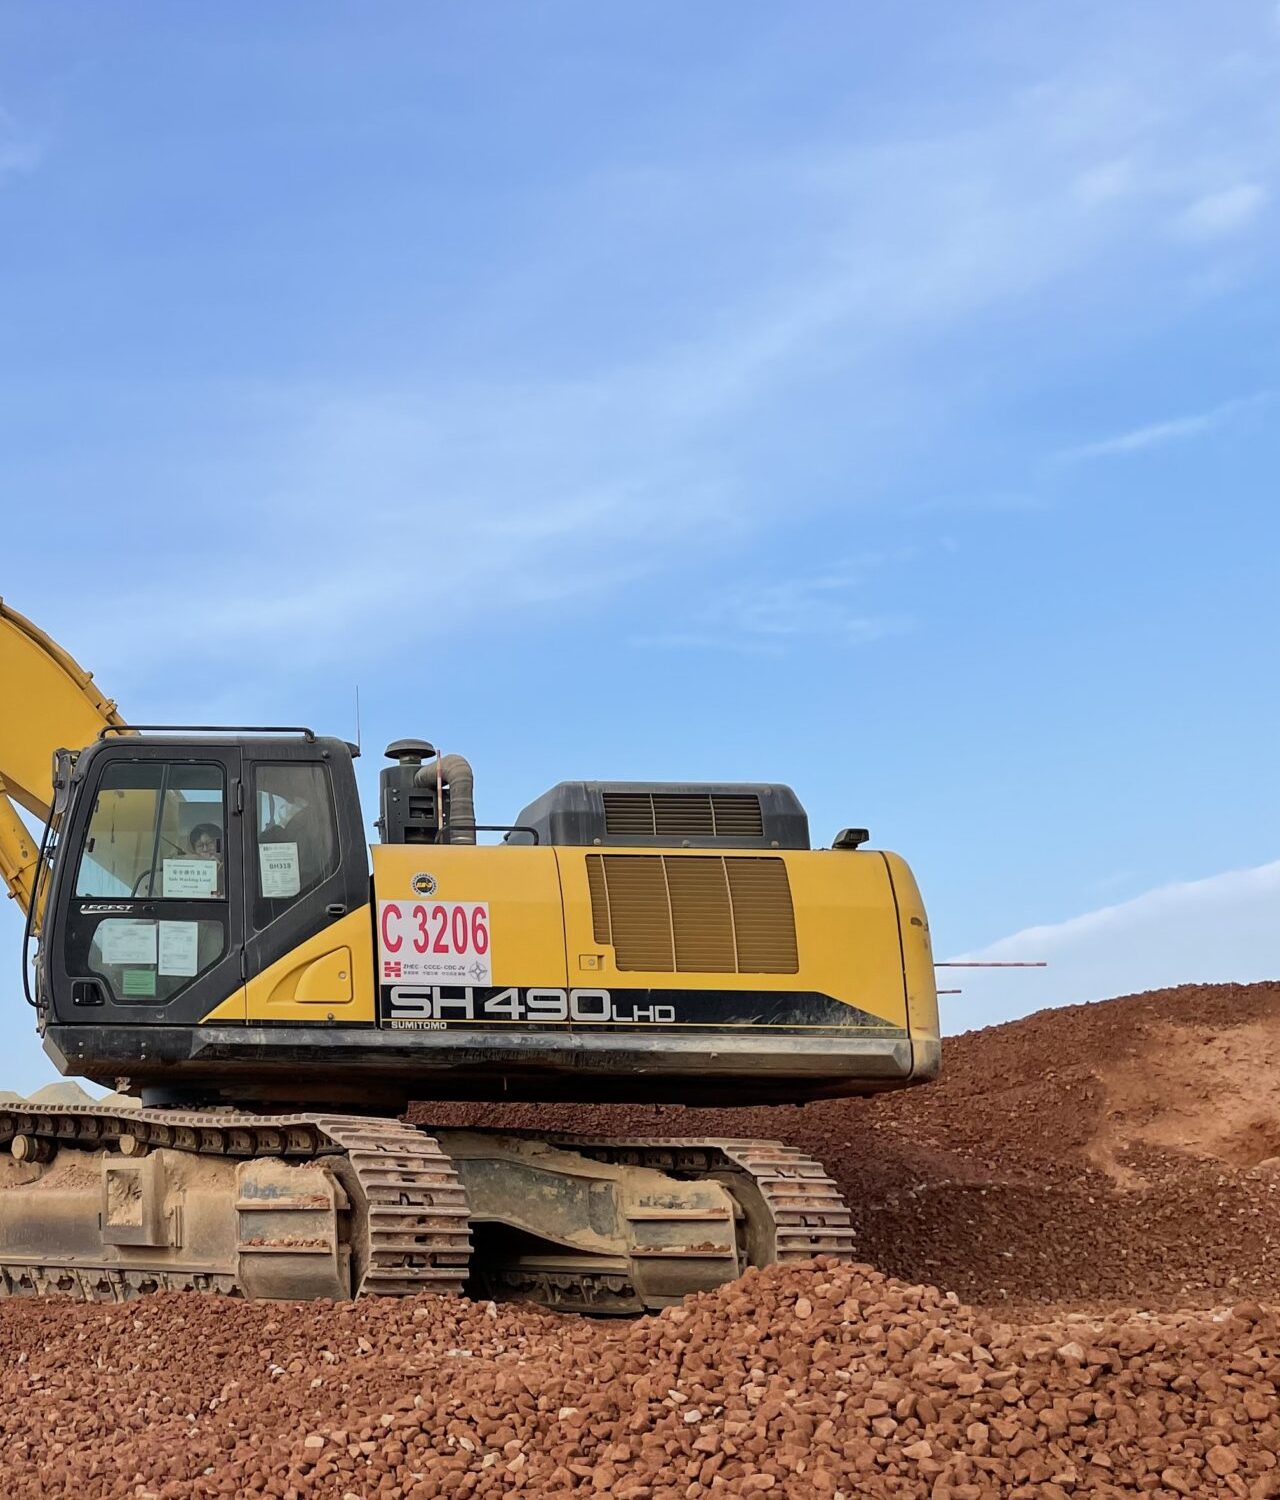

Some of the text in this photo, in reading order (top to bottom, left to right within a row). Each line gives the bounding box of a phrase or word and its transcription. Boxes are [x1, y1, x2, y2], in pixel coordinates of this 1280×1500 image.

[80, 904, 134, 912] LEGEST
[381, 903, 489, 955] C 3206
[390, 986, 474, 1019] SH
[391, 1020, 448, 1030] SUMITOMO
